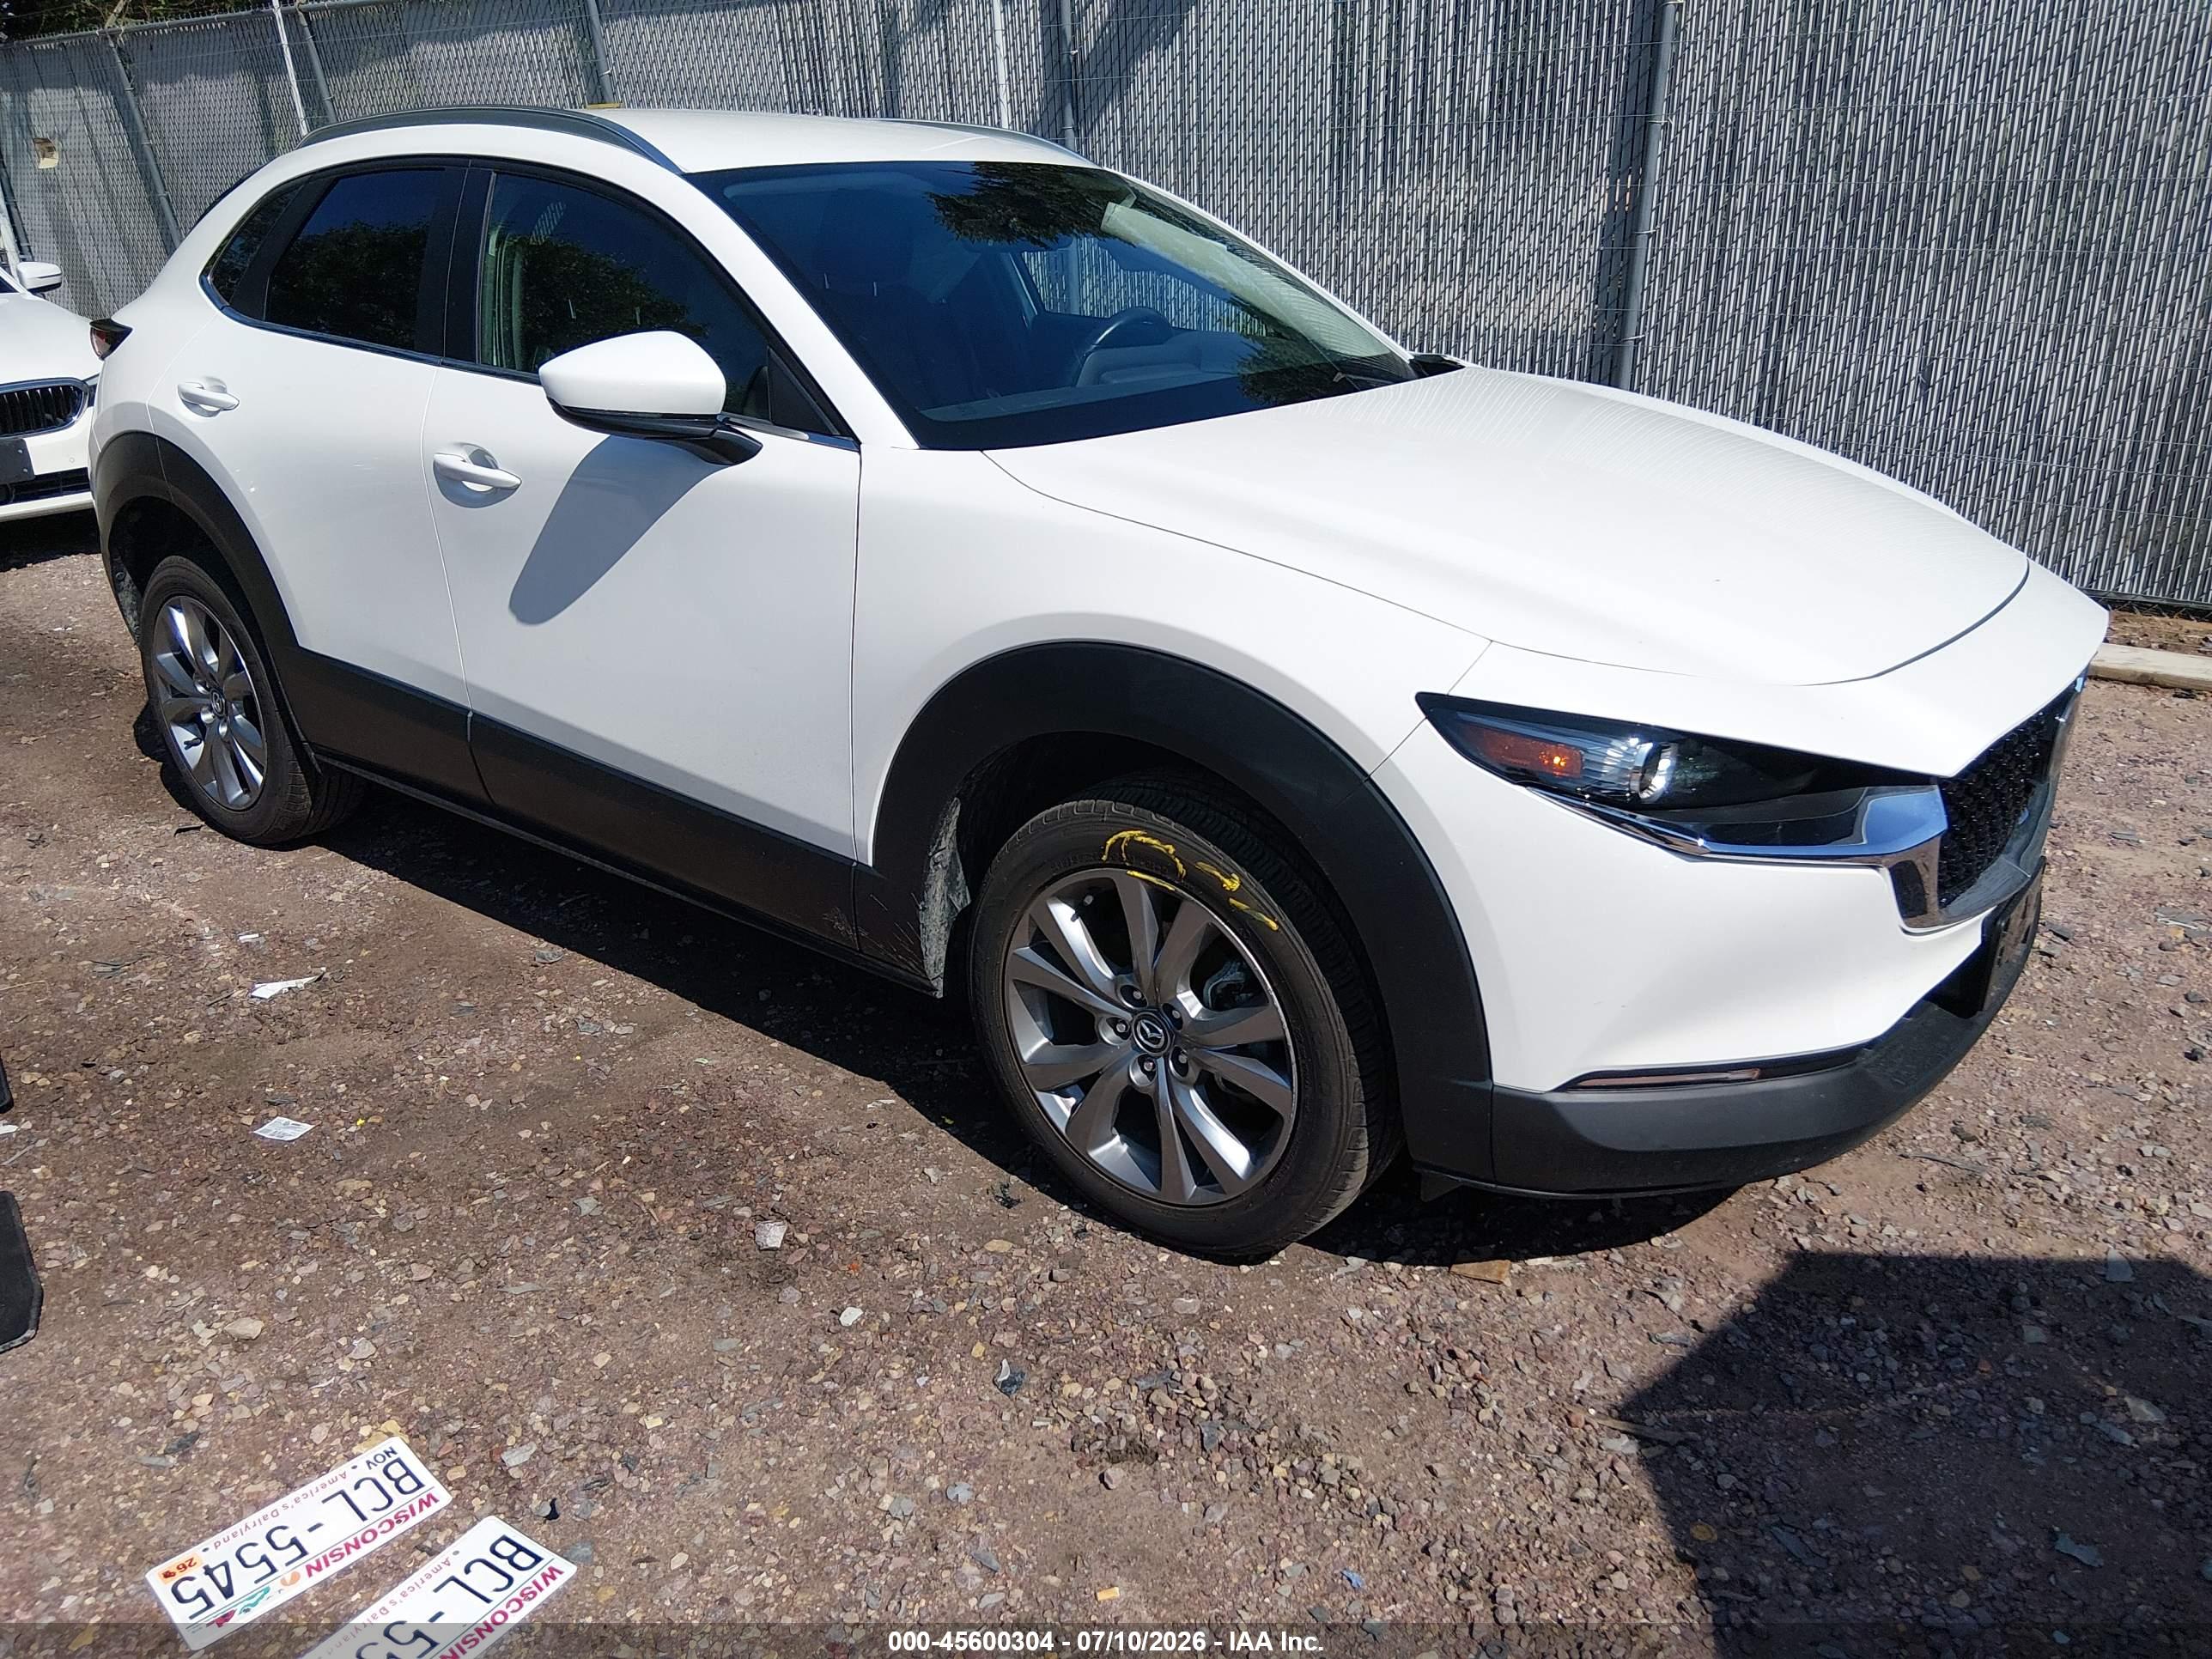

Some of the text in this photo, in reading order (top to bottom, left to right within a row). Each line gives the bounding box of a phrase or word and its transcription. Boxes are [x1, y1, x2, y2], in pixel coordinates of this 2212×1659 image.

[366, 1446, 398, 1470] NOV
[214, 1470, 348, 1550] America's Dairyland
[305, 1492, 440, 1578] WISCONSIN
